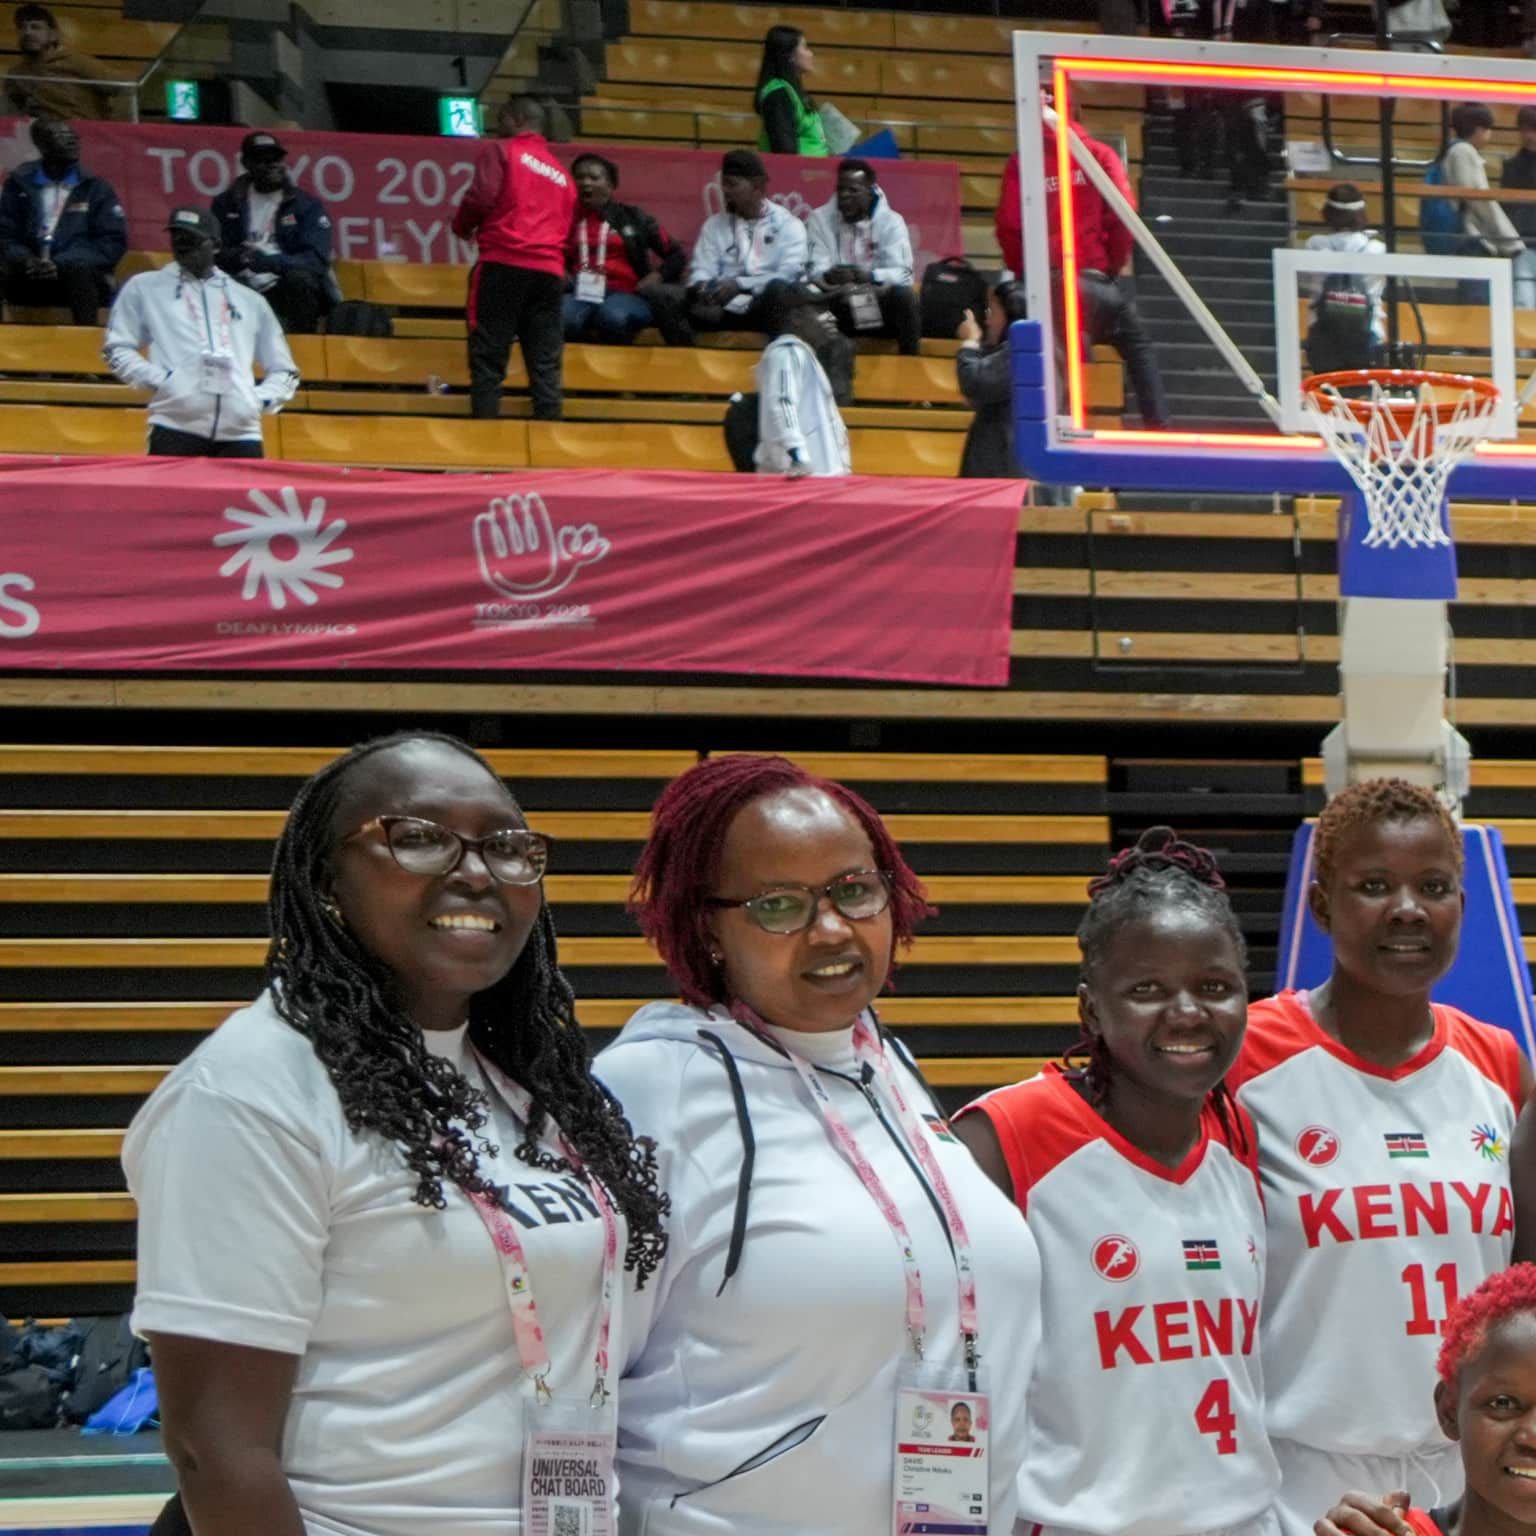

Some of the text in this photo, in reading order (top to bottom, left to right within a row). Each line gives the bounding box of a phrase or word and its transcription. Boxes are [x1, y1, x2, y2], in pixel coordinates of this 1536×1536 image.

[376, 157, 476, 207] 202
[492, 1173, 602, 1229] KEN
[1299, 1181, 1516, 1248] KENYA
[1402, 1263, 1458, 1336] 11
[1194, 1379, 1238, 1456] 4
[530, 1478, 606, 1497] CHAT BOARD
[532, 1457, 600, 1478] UNIVERSAL
